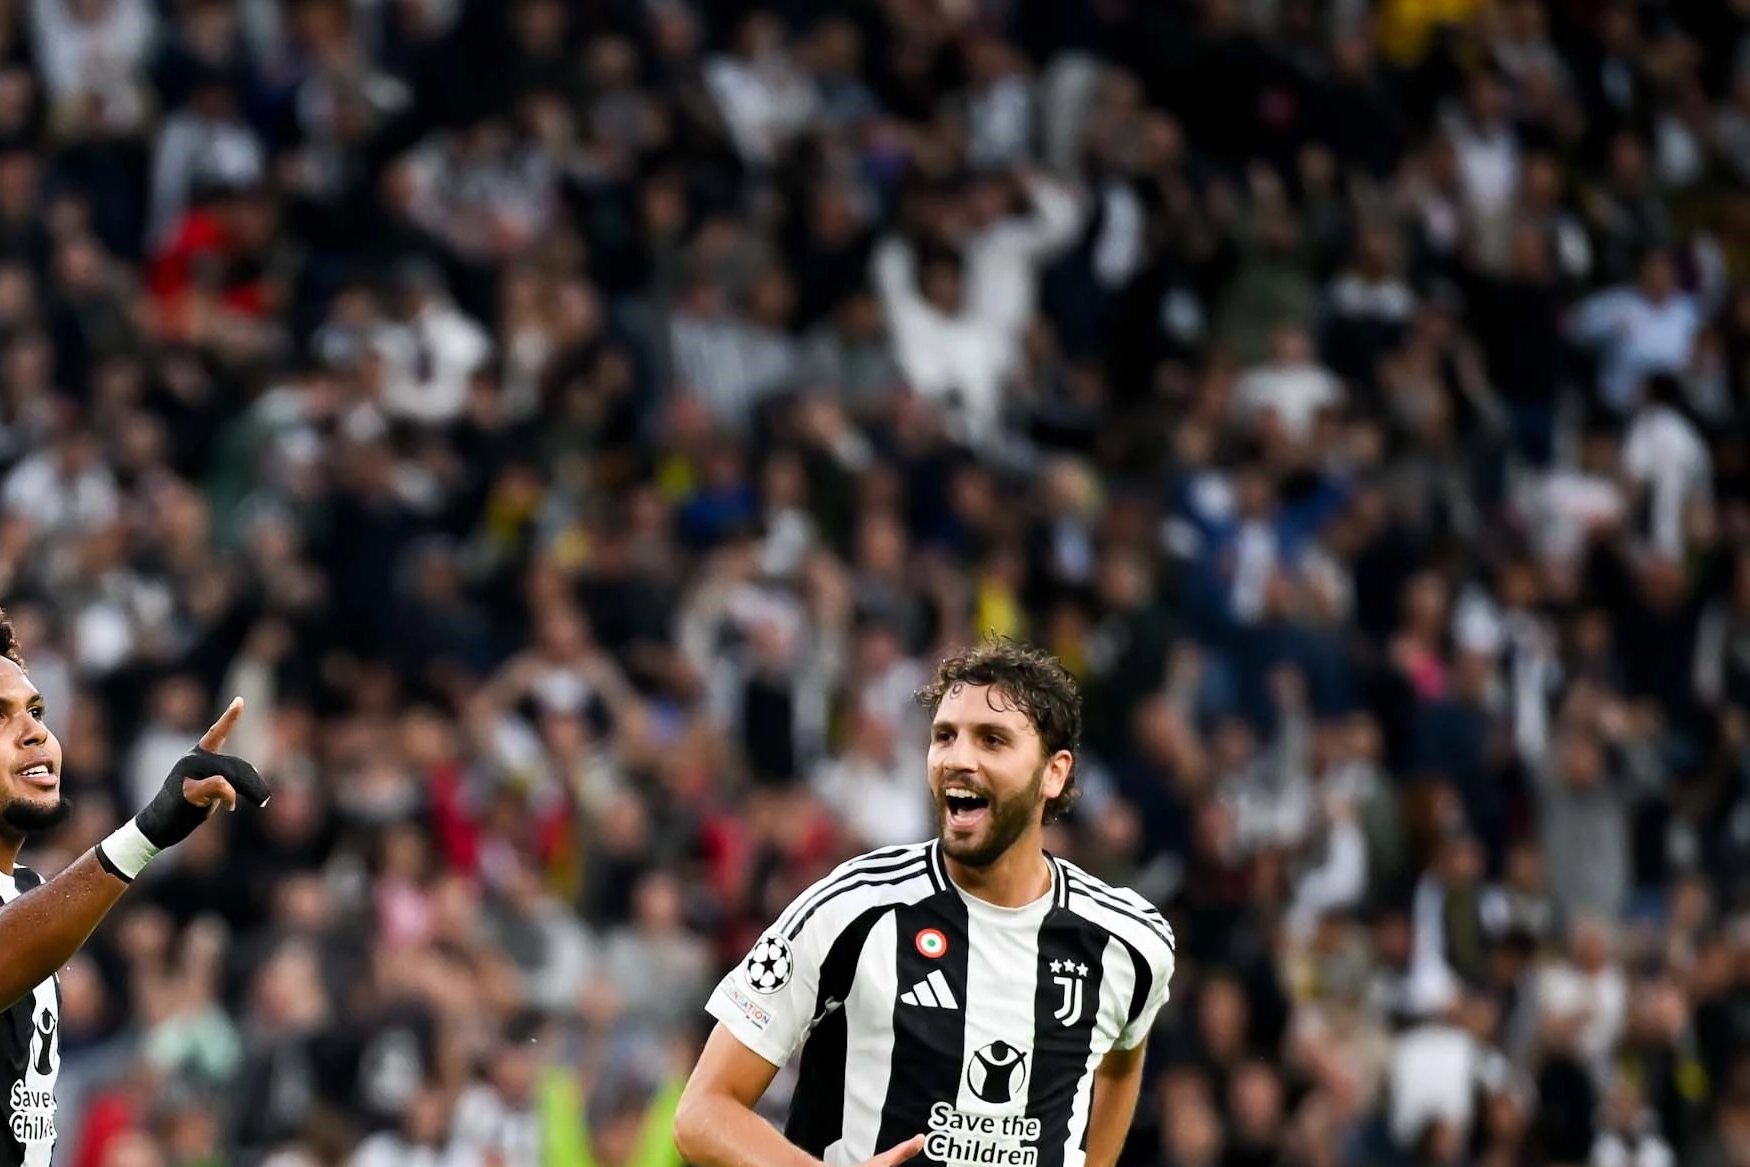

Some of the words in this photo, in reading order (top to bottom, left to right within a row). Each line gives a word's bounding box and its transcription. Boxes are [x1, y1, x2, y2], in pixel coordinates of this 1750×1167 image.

[13, 1083, 51, 1108] Save
[933, 1105, 995, 1133] Save
[1002, 1115, 1038, 1136] the
[927, 1134, 1035, 1165] Children
